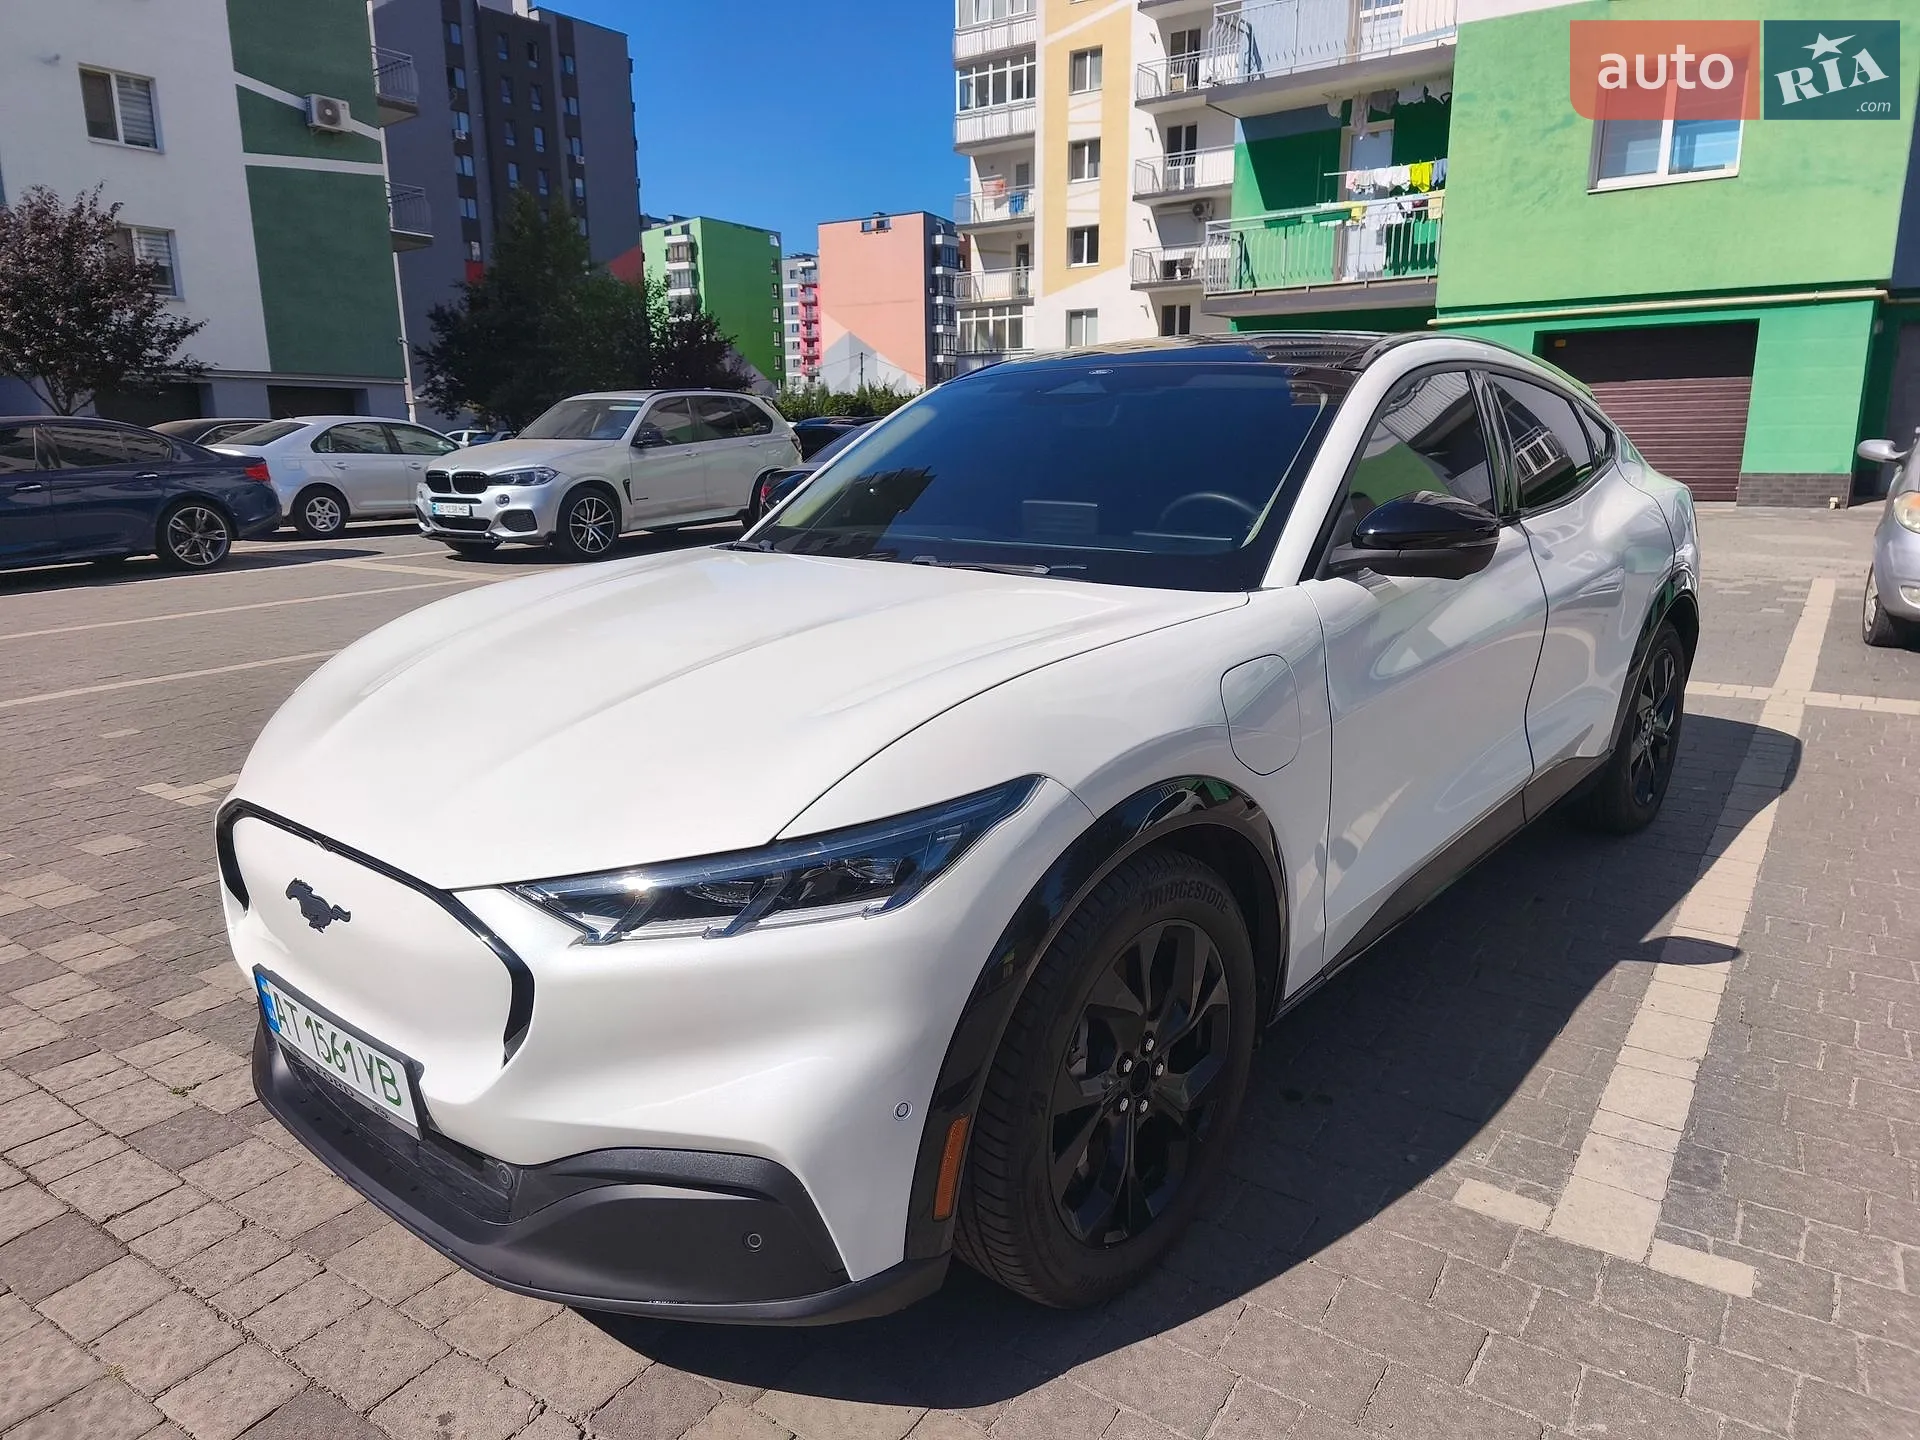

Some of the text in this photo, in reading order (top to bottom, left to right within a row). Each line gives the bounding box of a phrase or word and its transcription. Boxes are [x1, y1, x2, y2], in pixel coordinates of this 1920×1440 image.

[1140, 880, 1228, 914] BRIDGESTONE
[273, 991, 402, 1107] AT 1561 YB
